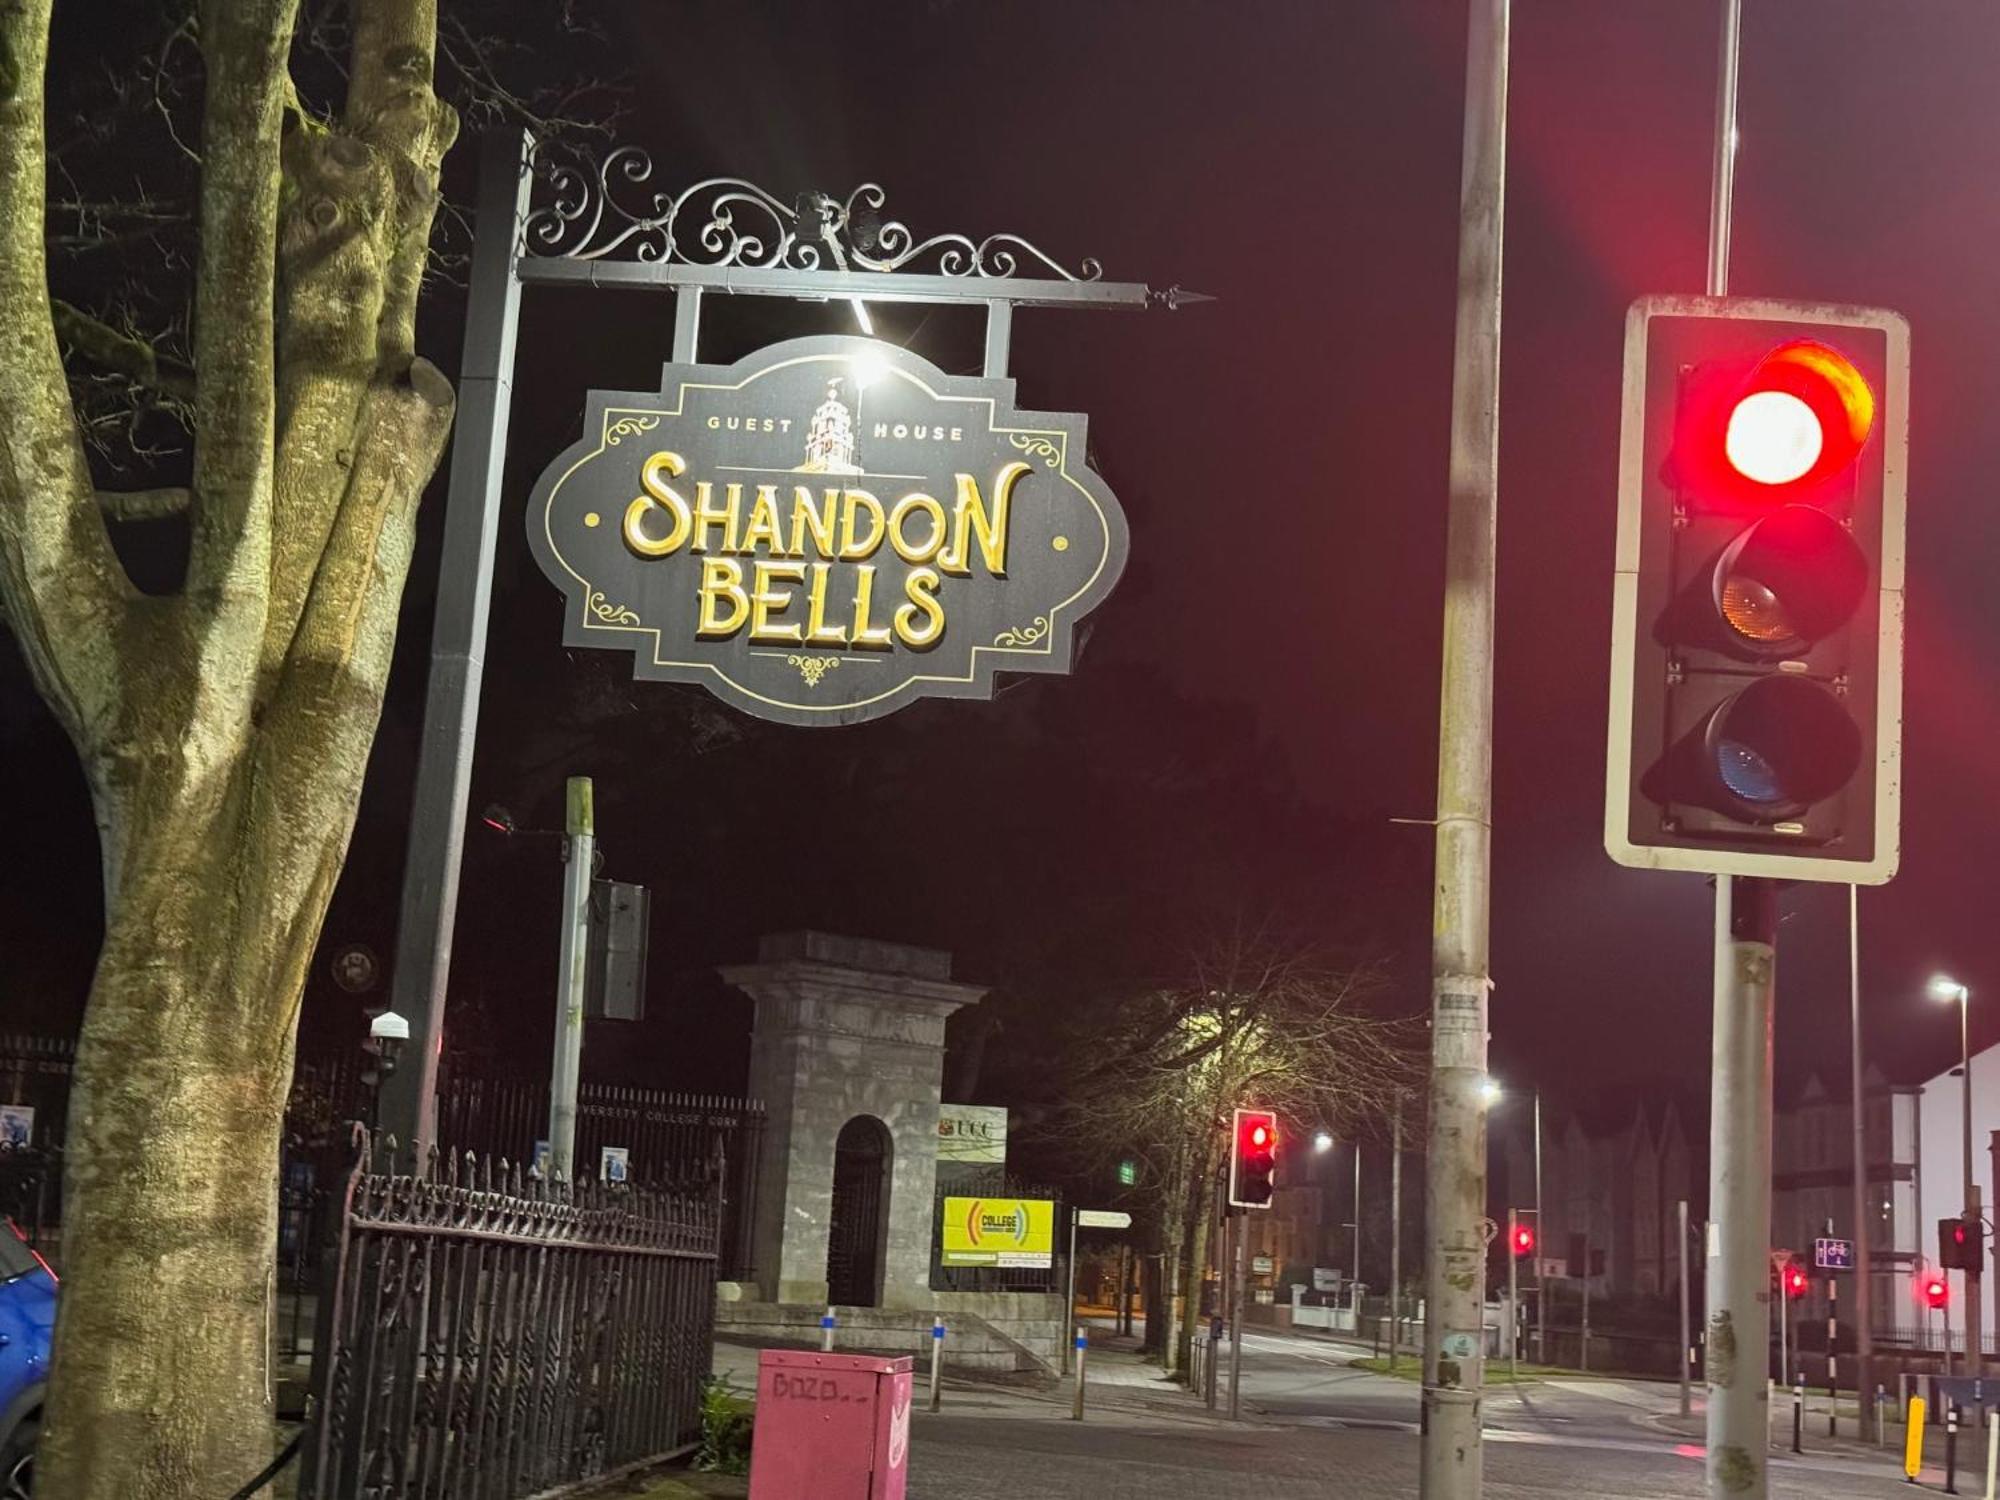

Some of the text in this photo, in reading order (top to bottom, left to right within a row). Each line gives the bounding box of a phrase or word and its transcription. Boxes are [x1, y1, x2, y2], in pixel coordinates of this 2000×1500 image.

[707, 416, 962, 441] GUEST HOUSE
[622, 451, 1033, 577] SHANDON
[696, 556, 945, 651] BELLS
[647, 1110, 700, 1125] COLLEGE
[708, 1115, 738, 1127] CORK
